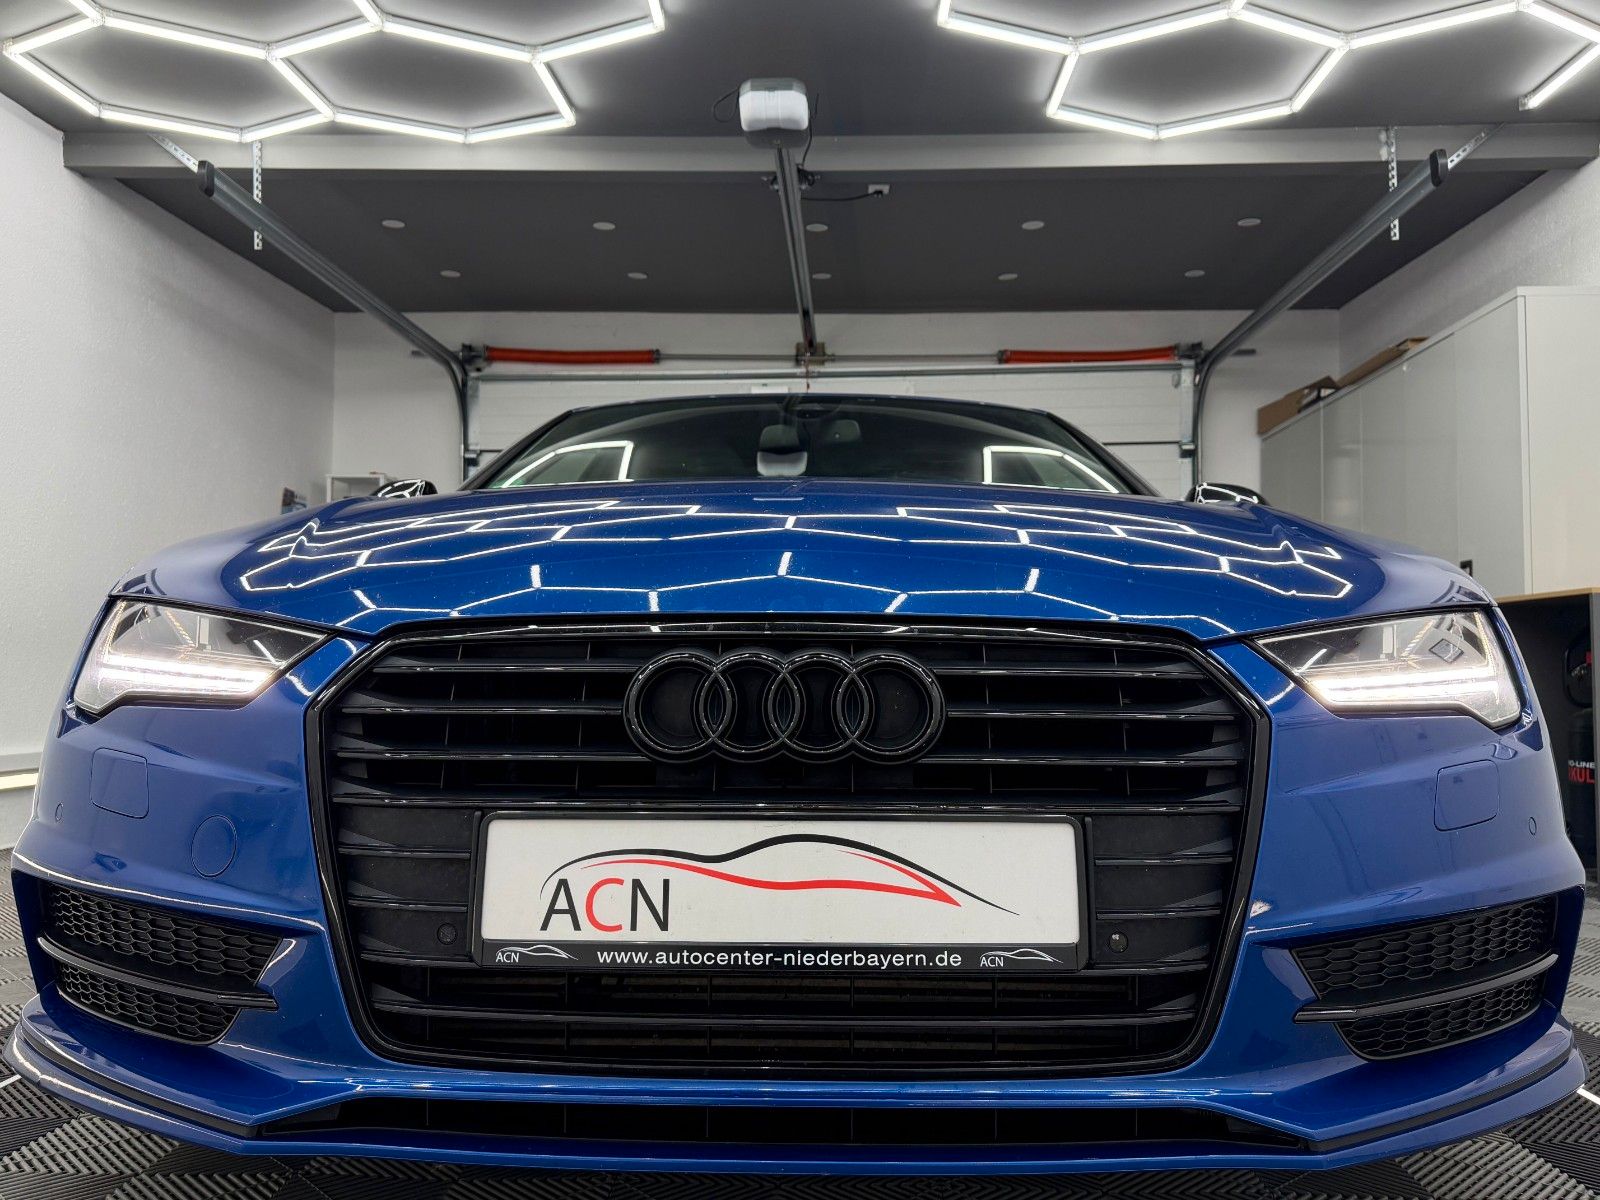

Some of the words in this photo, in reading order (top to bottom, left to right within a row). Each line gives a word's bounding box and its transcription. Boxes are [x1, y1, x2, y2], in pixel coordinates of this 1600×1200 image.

[540, 877, 670, 932] ACN
[495, 951, 520, 963] ACN
[597, 949, 962, 970] www.autocenter-niederbayern.de
[979, 956, 1004, 968] ACN
